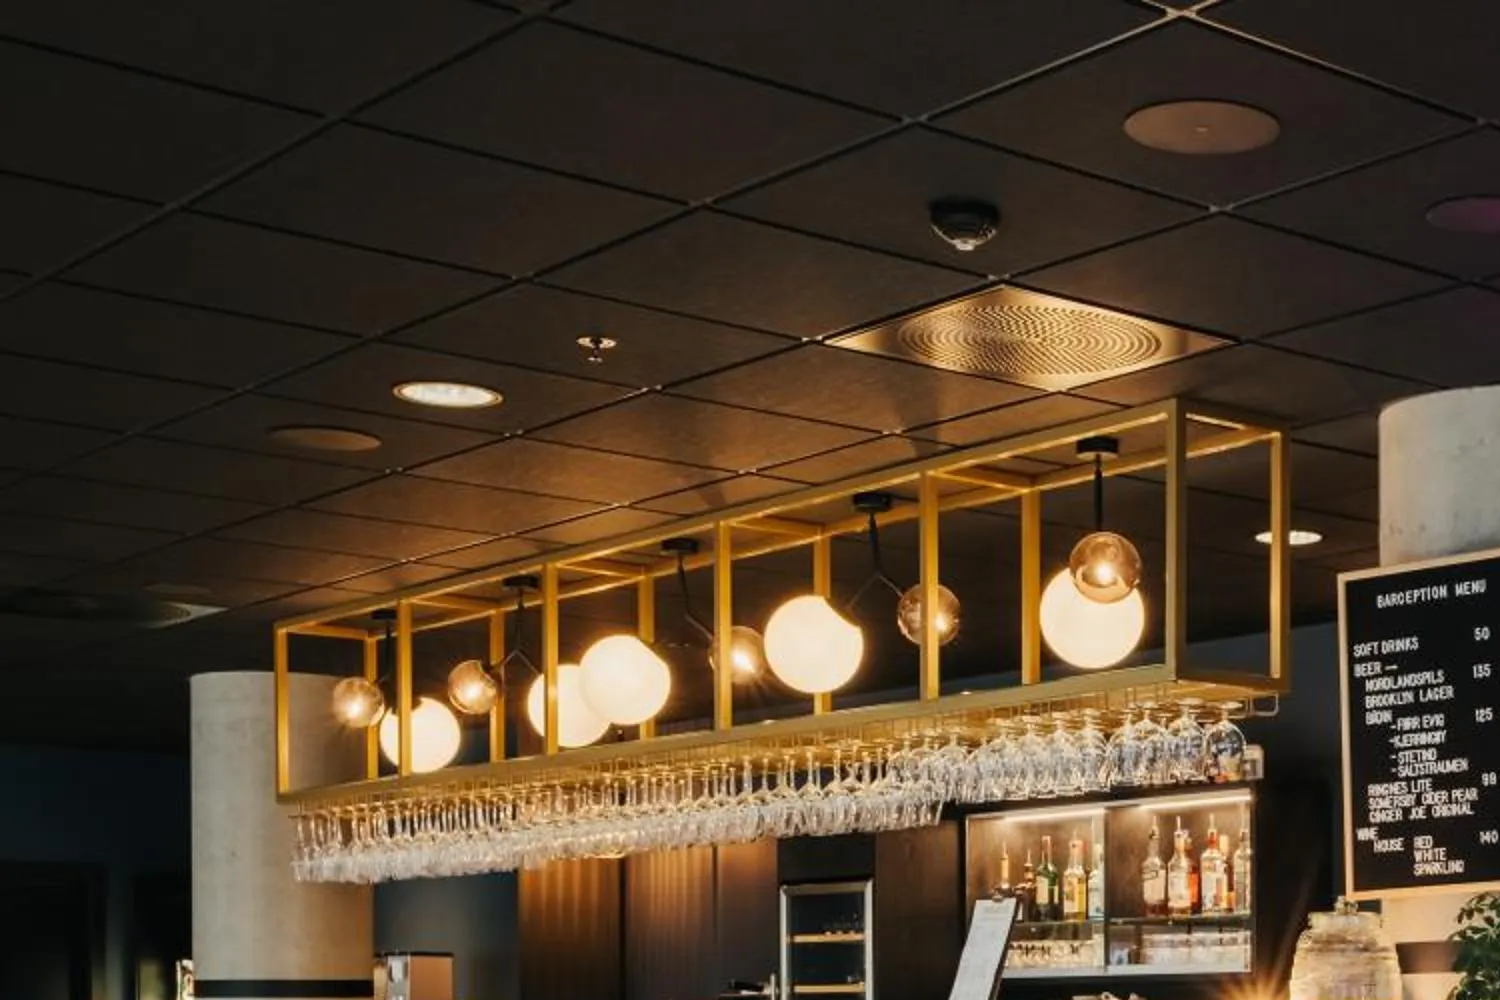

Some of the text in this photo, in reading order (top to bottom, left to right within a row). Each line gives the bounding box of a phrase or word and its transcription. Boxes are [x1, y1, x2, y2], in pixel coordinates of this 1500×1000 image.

[1376, 579, 1487, 608] BARCEPTION MENU
[1353, 626, 1491, 657] SOFT DRINKS 50
[1354, 661, 1382, 677] BEER
[1365, 685, 1454, 709] BROOKLYN LAGER
[1368, 794, 1416, 810] SOMERSBY
[1413, 847, 1448, 862] WHITE
